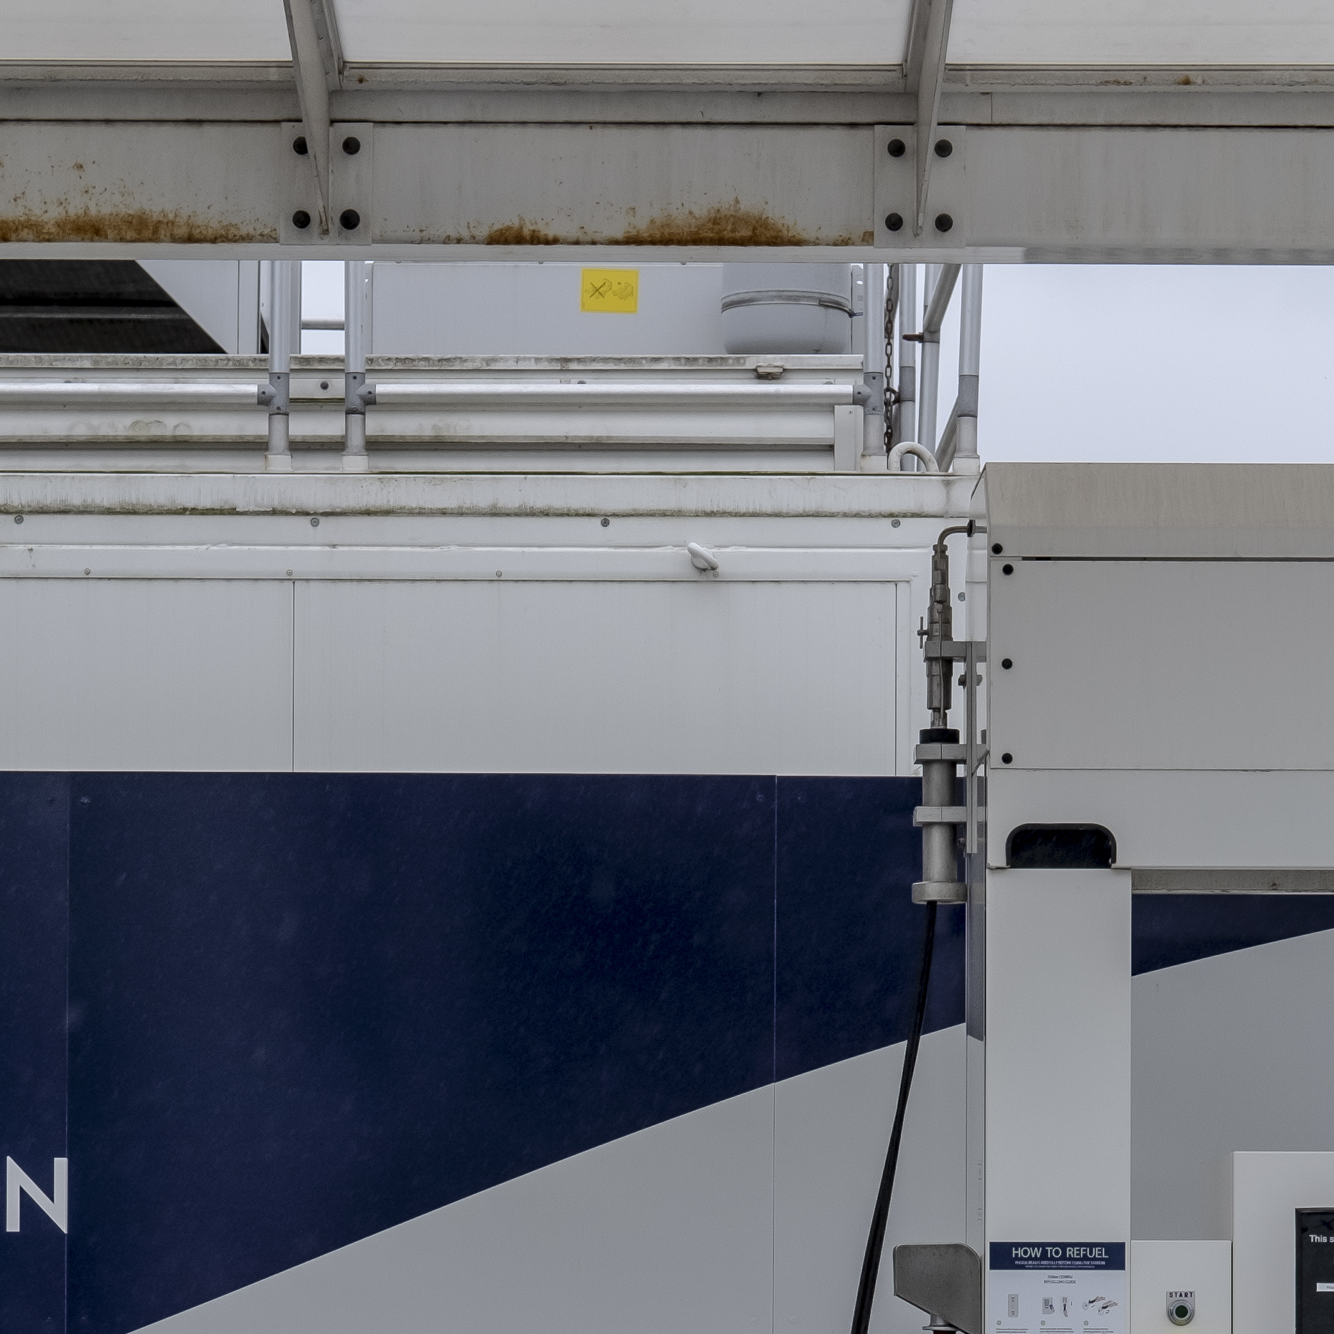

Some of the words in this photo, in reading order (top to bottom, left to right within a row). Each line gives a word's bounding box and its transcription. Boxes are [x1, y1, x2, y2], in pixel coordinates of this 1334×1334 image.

[1309, 1234, 1327, 1243] This
[1012, 1246, 1042, 1258] HOW
[1045, 1246, 1062, 1258] TO
[1066, 1246, 1109, 1258] REFUEL
